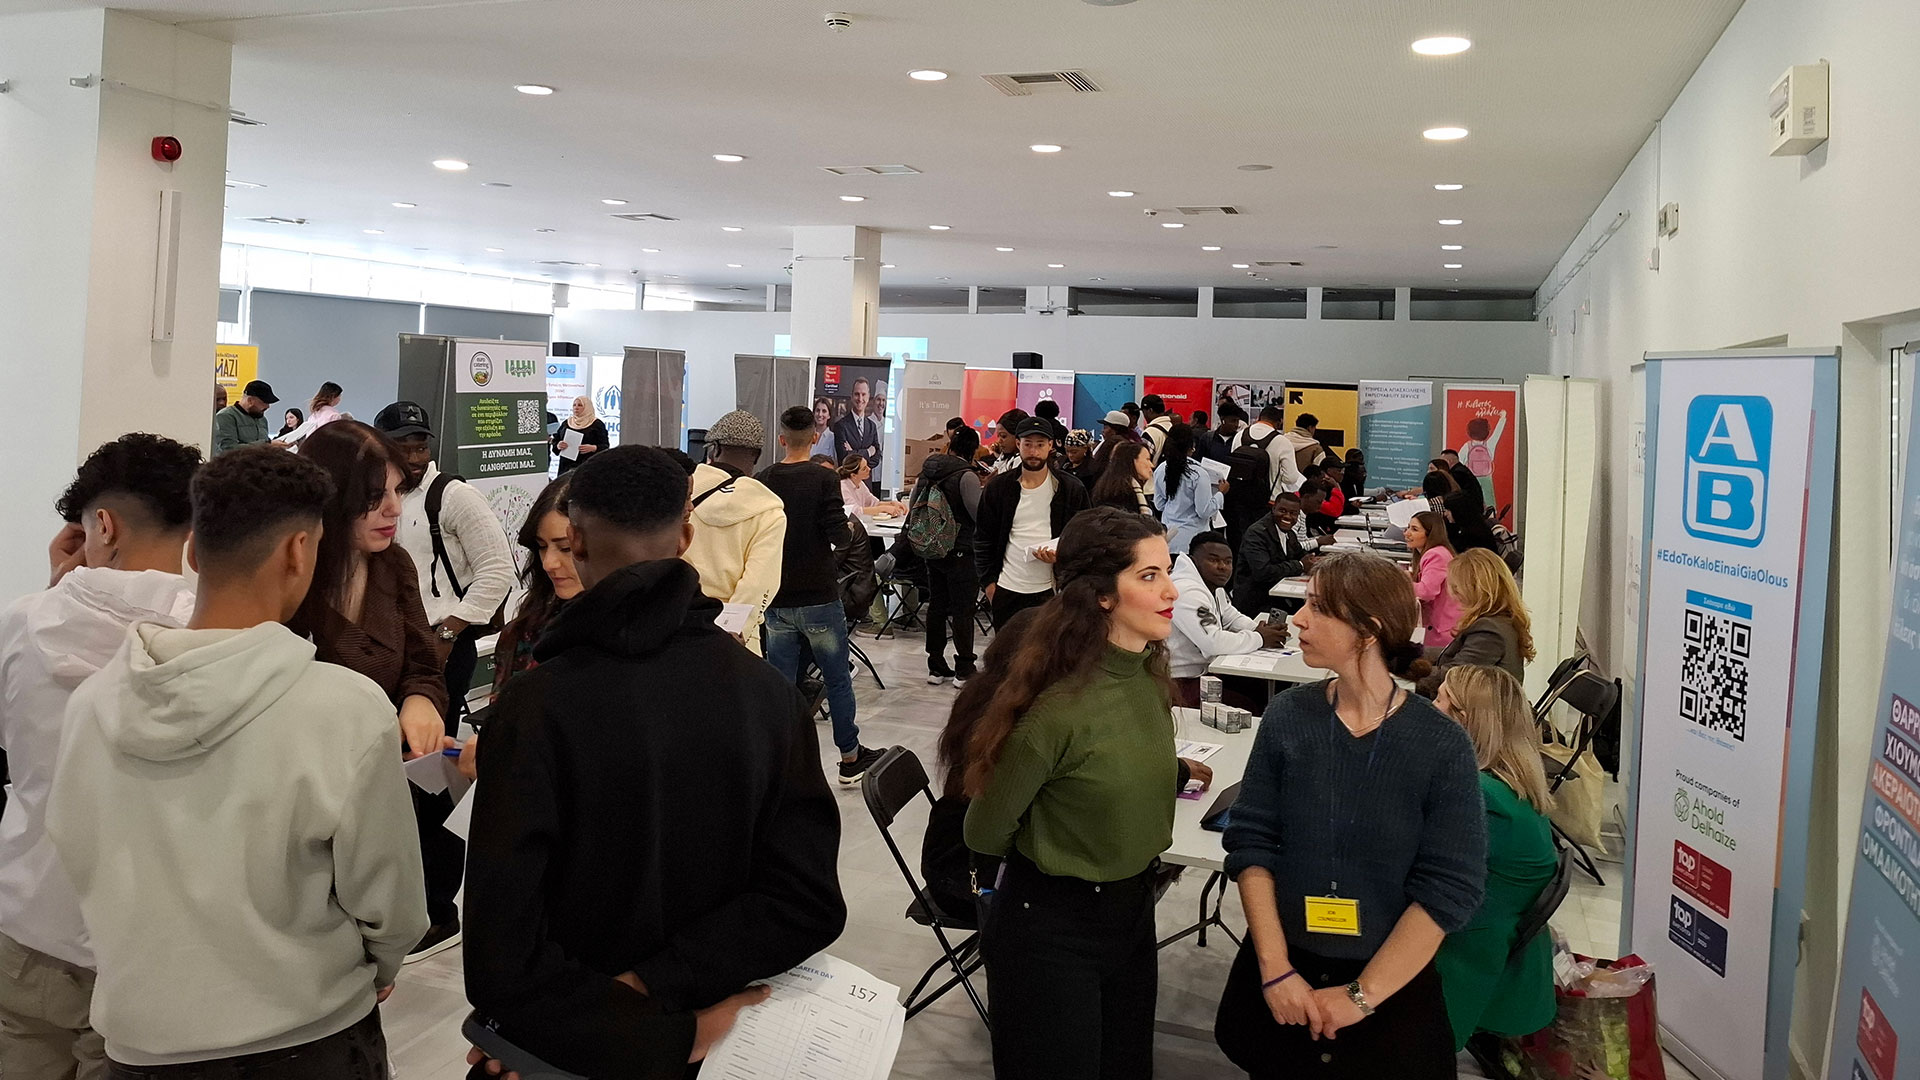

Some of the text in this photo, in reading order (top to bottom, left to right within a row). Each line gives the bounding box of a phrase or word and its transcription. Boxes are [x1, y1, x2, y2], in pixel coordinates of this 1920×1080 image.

[932, 401, 950, 409] Time
[487, 461, 519, 471] ΑΝΘΡΩΠΟΙ
[488, 449, 516, 458] ΔΥΝΑΜΗ
[1657, 549, 1788, 588] #EdoToKaloEinaiGiaOlous
[1892, 699, 1920, 740] ΘΑΡΡ
[1675, 769, 1741, 808] Proud companies of
[1692, 797, 1725, 825] Ahold
[1691, 813, 1737, 851] Delhaize
[1875, 805, 1920, 869] ΦΡΟΝΤΙΔ
[1677, 846, 1696, 872] top
[1673, 901, 1692, 928] top
[820, 971, 834, 979] DAY
[848, 985, 878, 1003] 157
